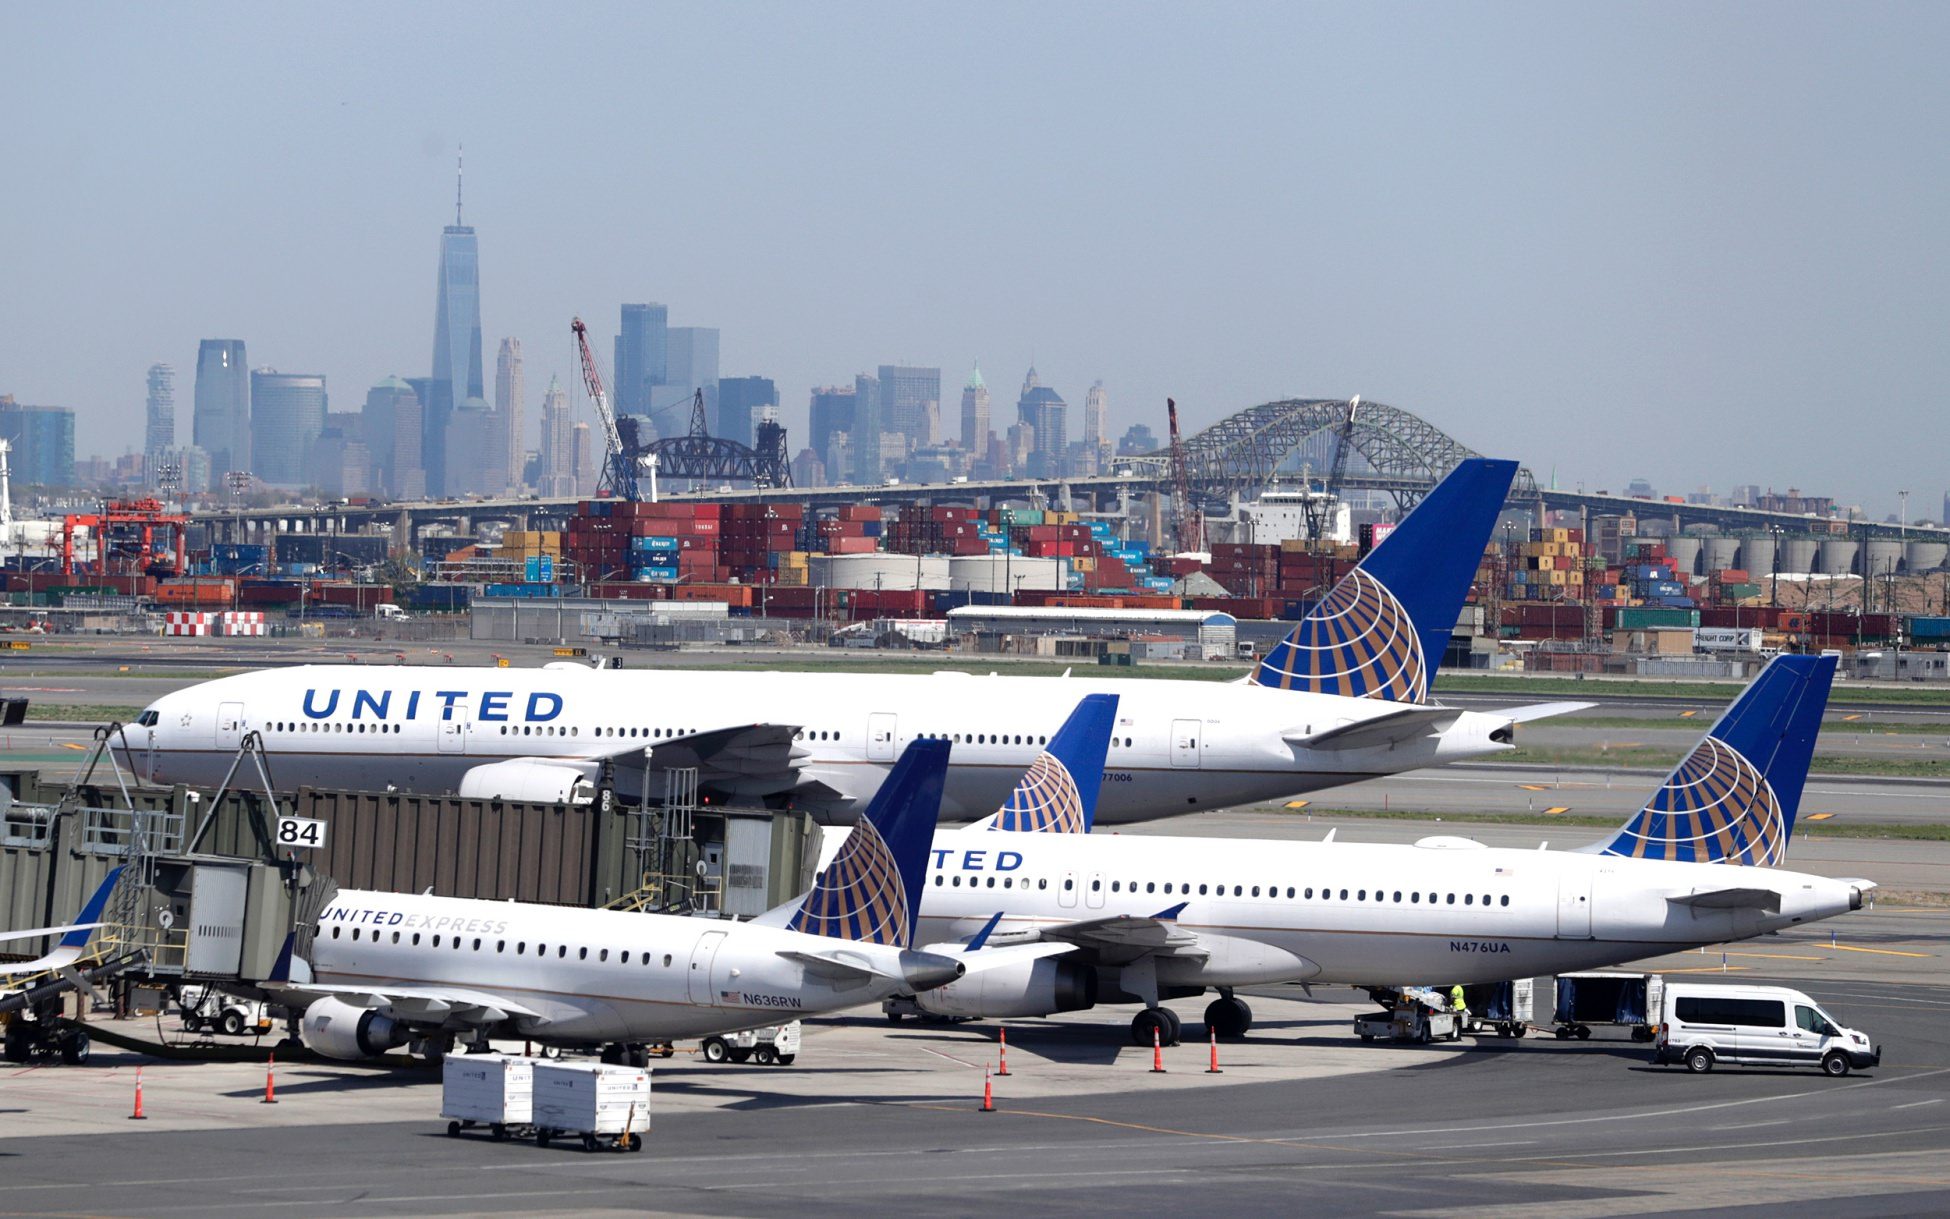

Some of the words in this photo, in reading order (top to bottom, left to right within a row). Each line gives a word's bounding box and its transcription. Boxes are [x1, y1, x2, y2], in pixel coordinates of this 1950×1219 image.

[302, 689, 564, 722] UNITED
[1102, 773, 1133, 782] 77006
[279, 820, 319, 845] 84
[931, 849, 1023, 871] TED
[1450, 941, 1510, 953] N476UA
[743, 993, 801, 1008] N636RW
